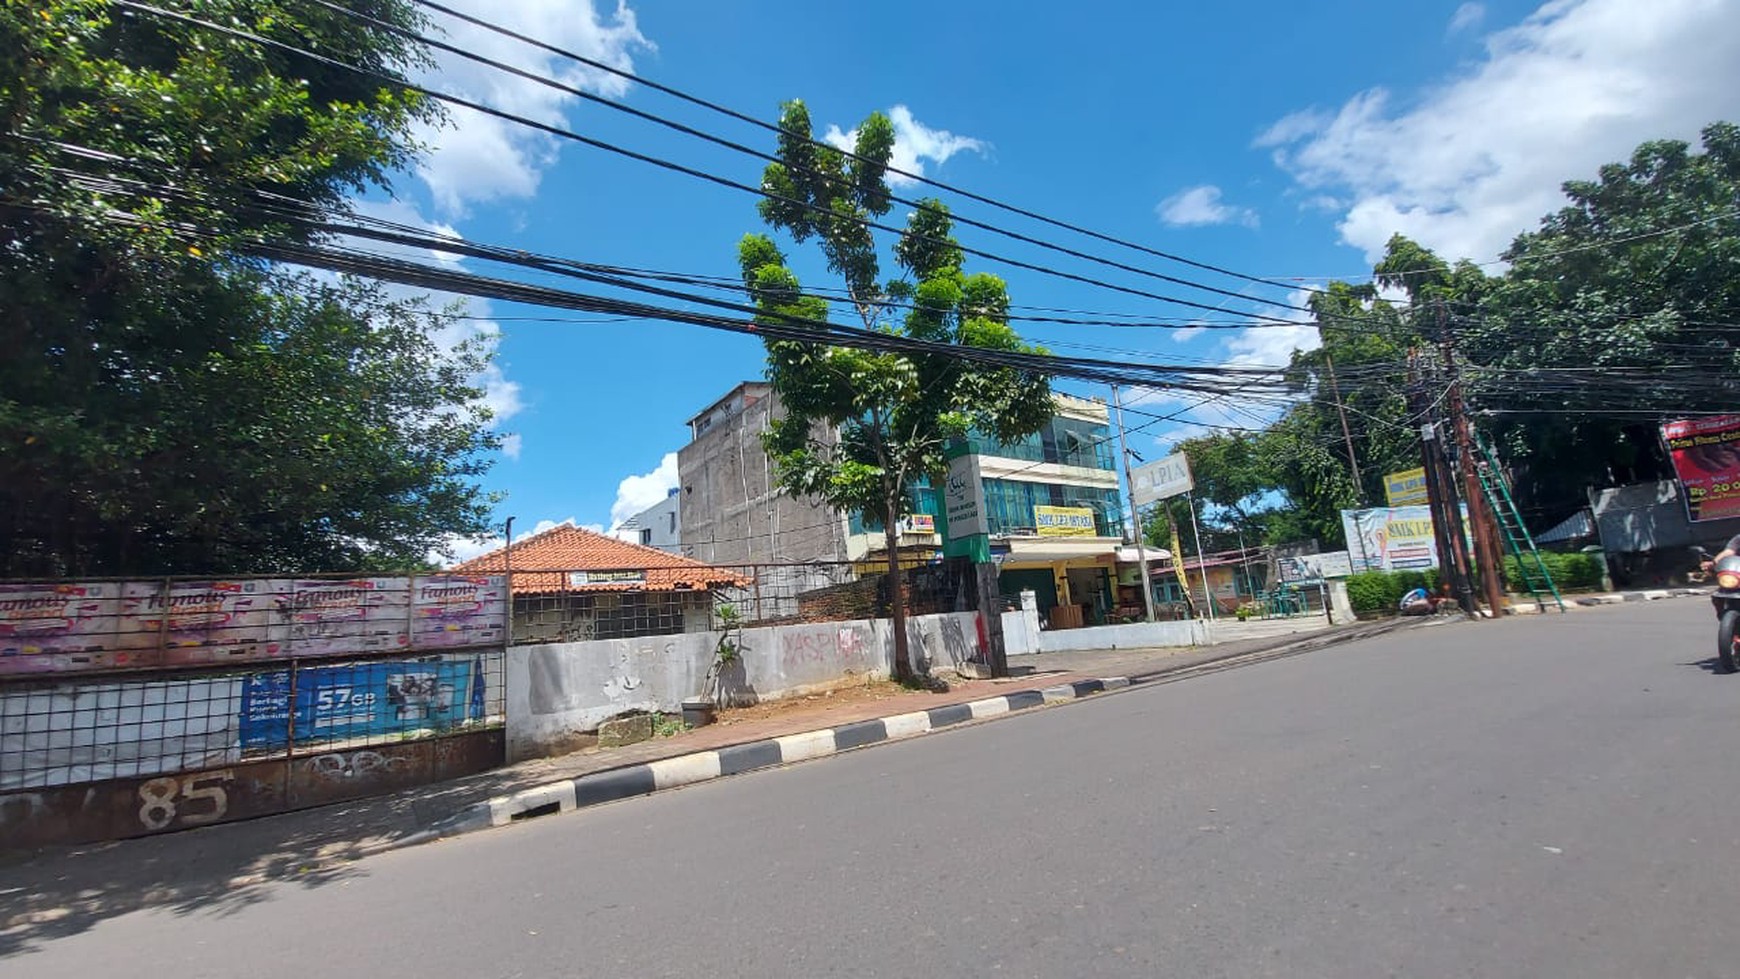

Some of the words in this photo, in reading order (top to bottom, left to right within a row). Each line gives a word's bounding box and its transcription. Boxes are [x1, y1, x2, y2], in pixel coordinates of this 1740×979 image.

[1150, 462, 1186, 488] LPIA
[0, 594, 69, 612] amous
[421, 584, 479, 600] Famous
[138, 769, 235, 831] 85
